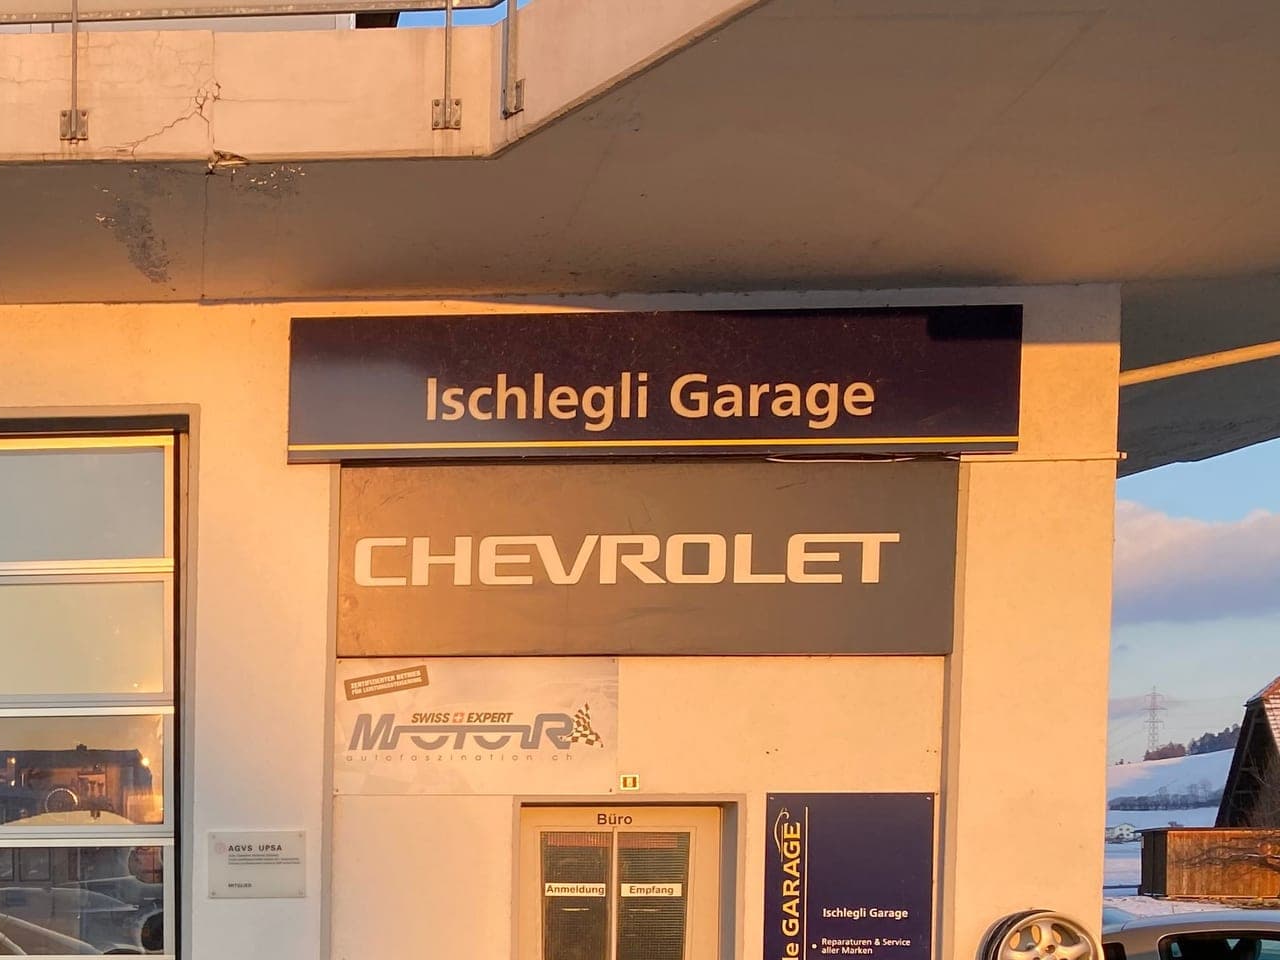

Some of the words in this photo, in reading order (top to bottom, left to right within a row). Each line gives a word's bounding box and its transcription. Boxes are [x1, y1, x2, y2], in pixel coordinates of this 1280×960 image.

[426, 372, 648, 432] Ischlegli
[670, 373, 875, 429] Garage
[353, 533, 900, 587] CHEVROLET
[411, 712, 450, 724] SWISS
[466, 712, 513, 724] EXPERT
[597, 813, 633, 825] Büro
[258, 844, 283, 852] UPSA
[782, 822, 801, 937] GARAGE
[546, 885, 605, 896] Anmeldung
[629, 885, 674, 896] Empfang
[823, 908, 866, 920] Ischlegli
[869, 908, 909, 920] Garage
[821, 938, 872, 948] Reparaturen
[874, 938, 881, 946] &
[882, 938, 911, 946] Service
[821, 946, 839, 954] aller
[841, 946, 873, 954] Marken
